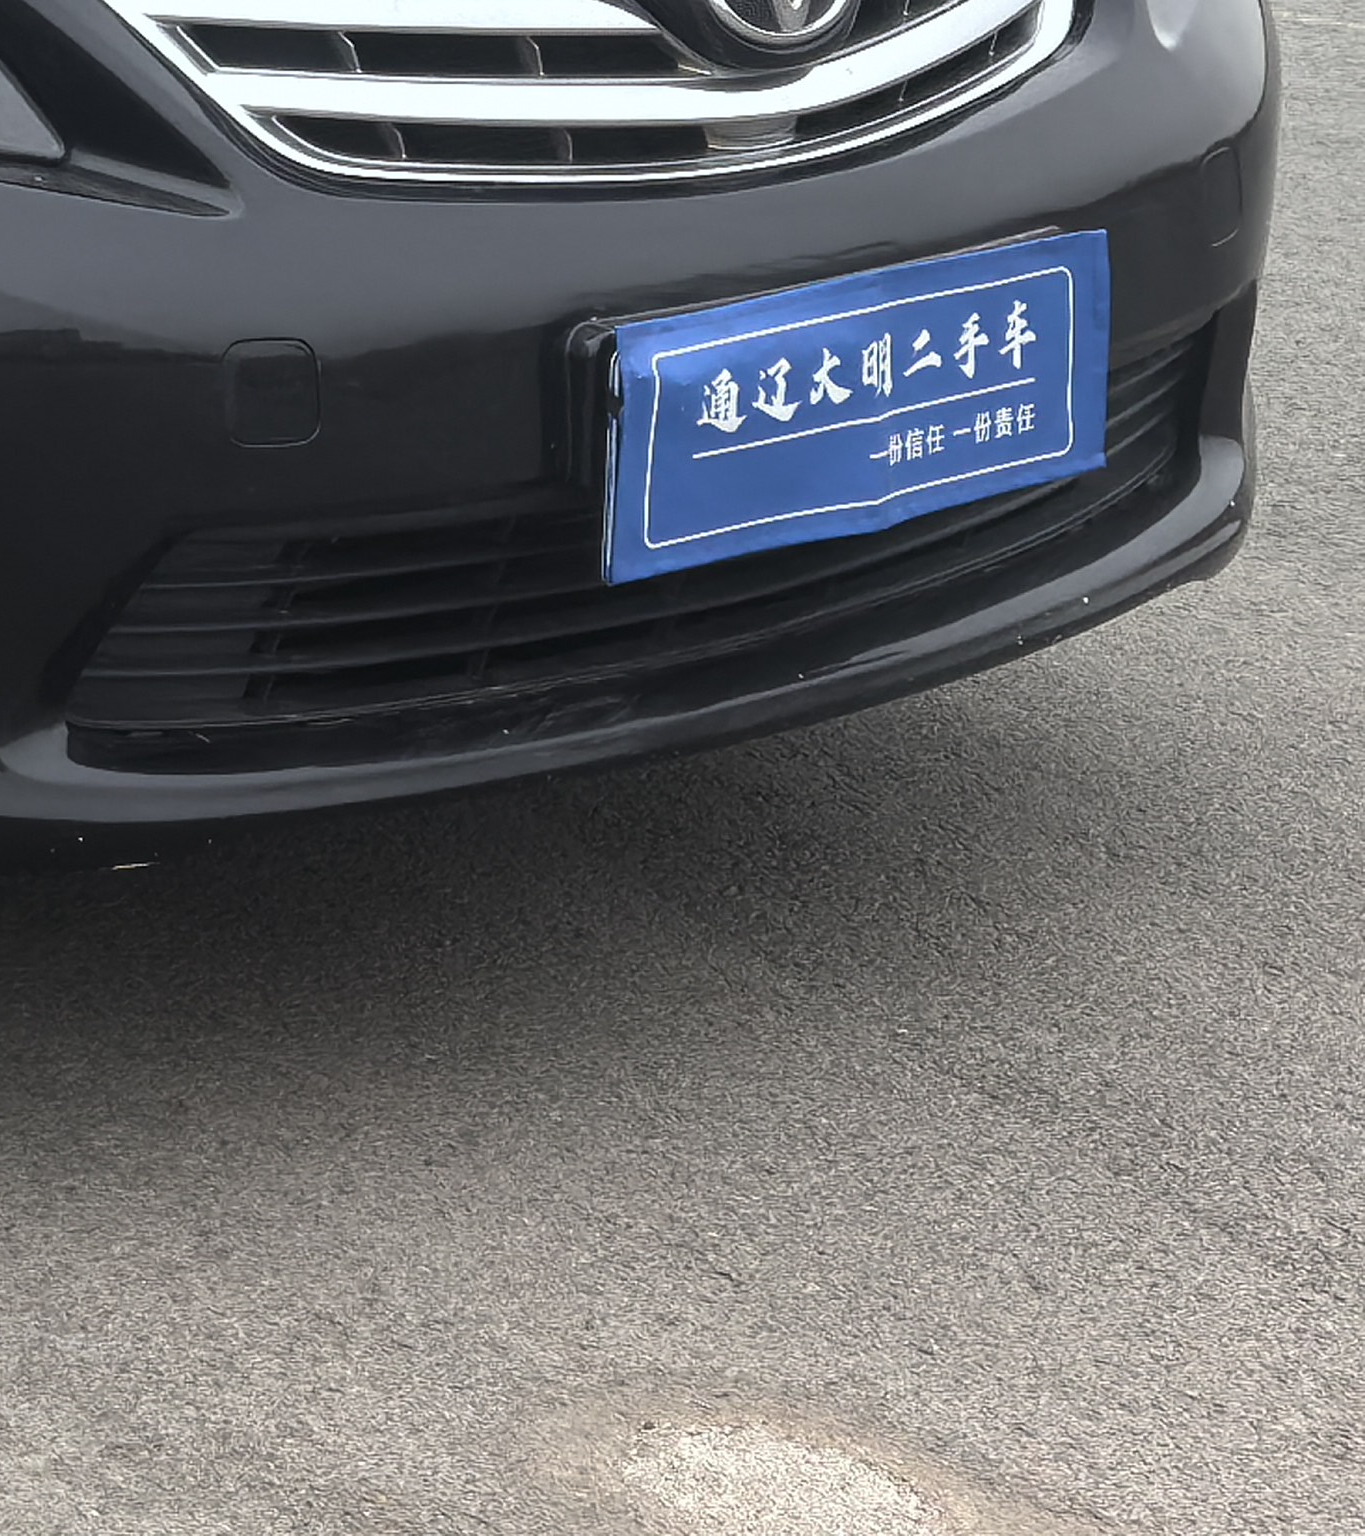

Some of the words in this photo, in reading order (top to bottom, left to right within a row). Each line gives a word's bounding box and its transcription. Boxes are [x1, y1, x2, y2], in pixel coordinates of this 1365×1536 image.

[869, 423, 946, 466] 一份信任
[953, 403, 1036, 444] 一份责任
